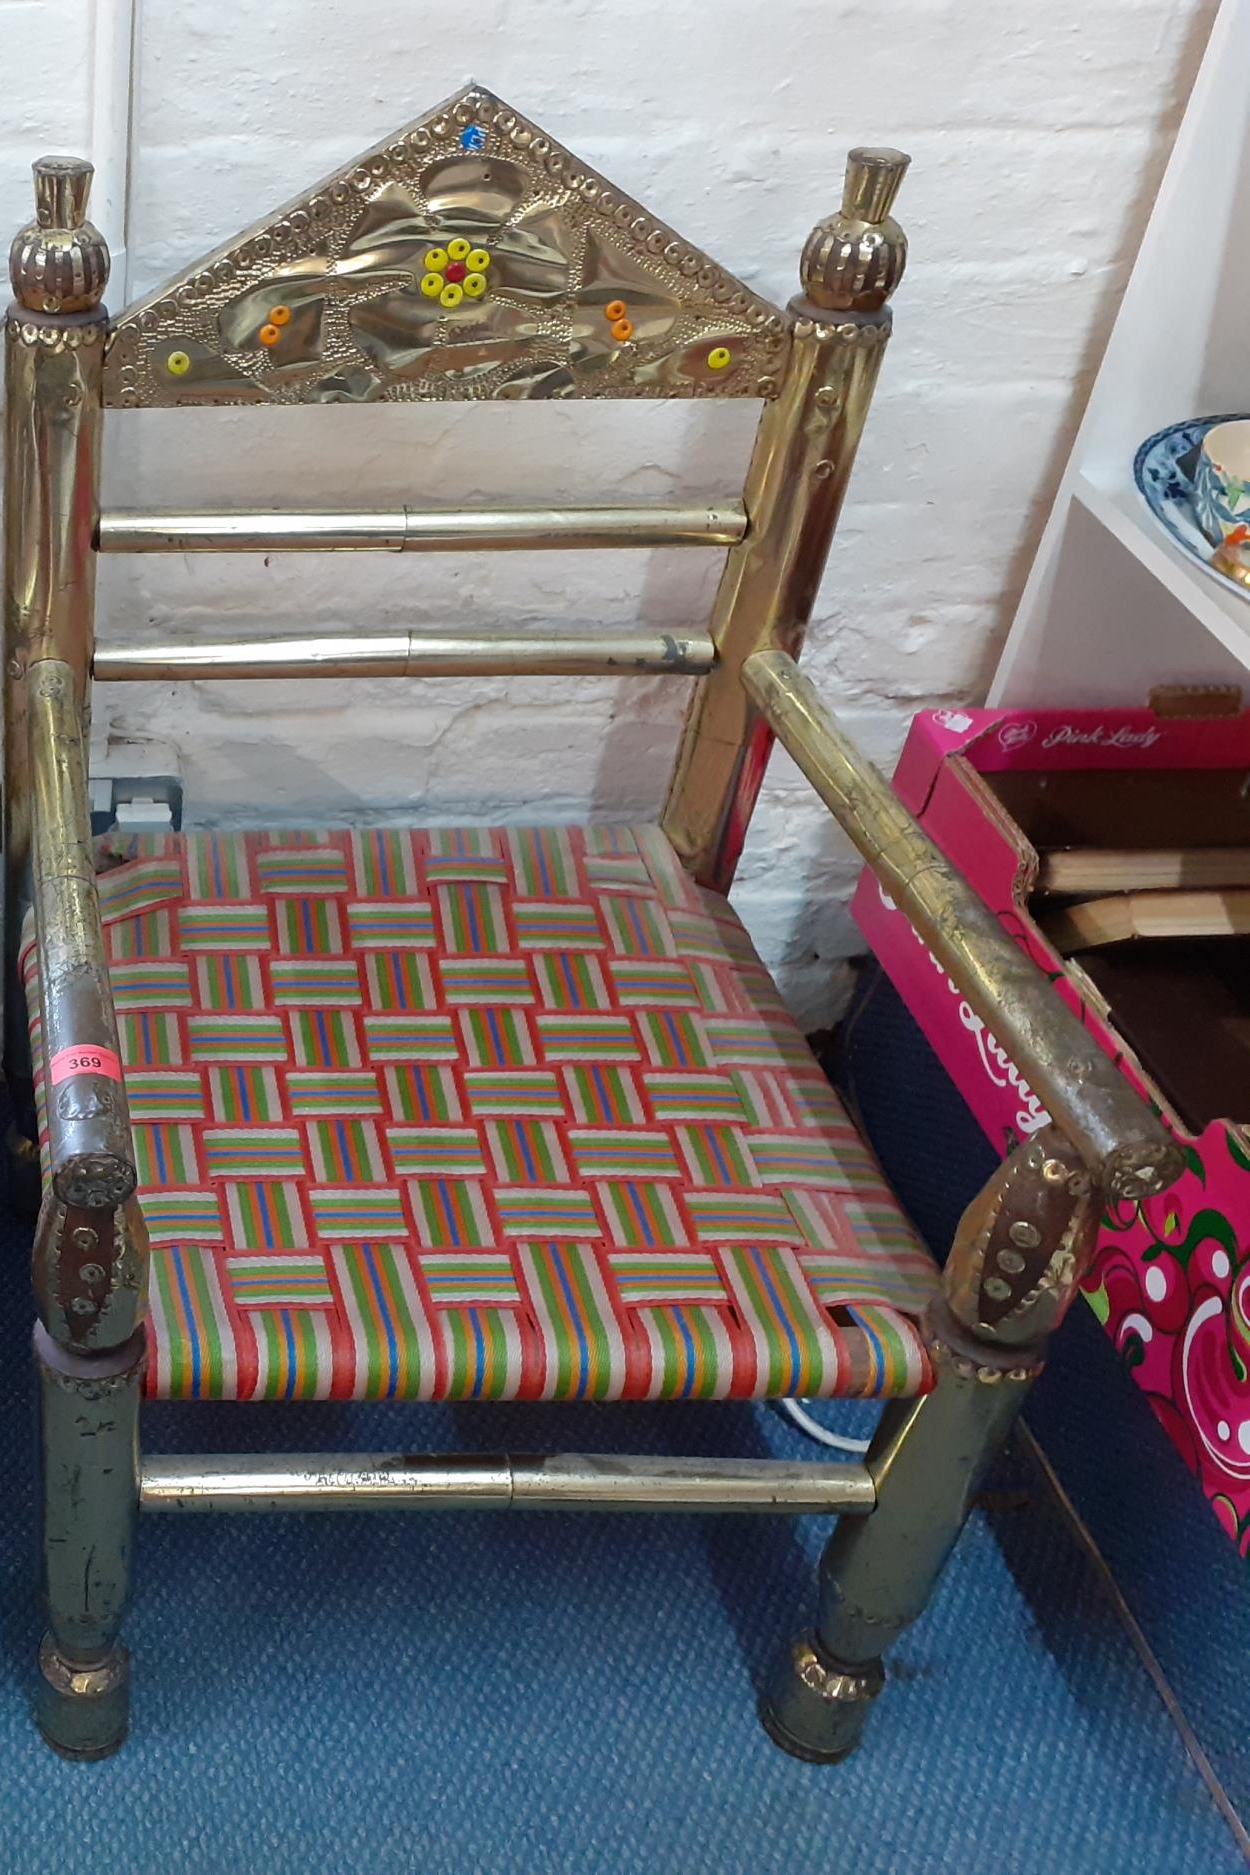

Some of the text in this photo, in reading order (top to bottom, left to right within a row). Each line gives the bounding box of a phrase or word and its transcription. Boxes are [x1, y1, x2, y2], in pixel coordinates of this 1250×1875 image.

[1042, 726, 1103, 748] Pink
[1102, 726, 1161, 748] Lady
[68, 1057, 102, 1070] 369
